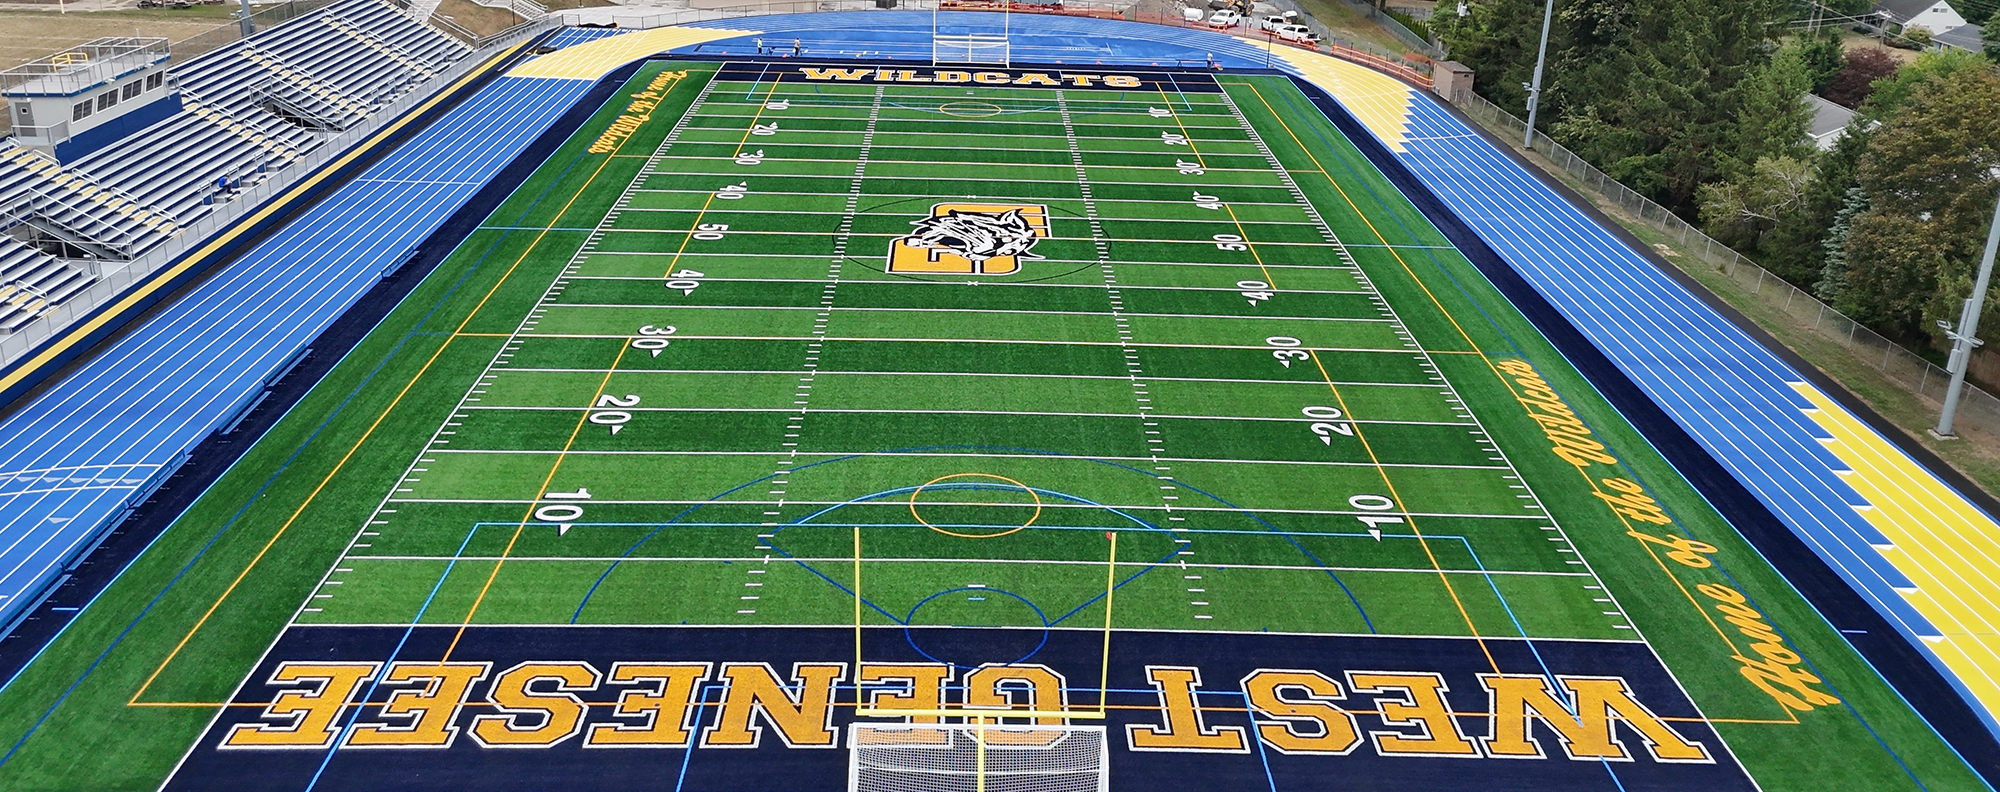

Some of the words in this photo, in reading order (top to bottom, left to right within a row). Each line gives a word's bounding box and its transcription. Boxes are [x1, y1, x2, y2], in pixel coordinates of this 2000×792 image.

[799, 67, 1142, 88] WILDCATS
[751, 123, 778, 136] 20
[1161, 133, 1189, 146] 20
[734, 152, 764, 166] 30
[1176, 162, 1205, 175] 30
[716, 184, 748, 200] 40
[1192, 195, 1225, 210] 40
[692, 223, 729, 241] 50
[1212, 233, 1249, 251] 50
[665, 269, 704, 290] 40
[1236, 280, 1275, 301] 40
[631, 325, 677, 349] 30
[1265, 336, 1310, 361] 30
[588, 394, 641, 424] 20
[1301, 405, 1354, 436] 20
[1497, 359, 1617, 467] Wildcats
[533, 488, 592, 521] 10
[1348, 494, 1405, 524] 10
[1592, 477, 1672, 525] the
[1627, 534, 1718, 569] of
[1697, 583, 1842, 711] Home
[217, 660, 1071, 750] GENESEE
[1125, 665, 1716, 764] WEST
